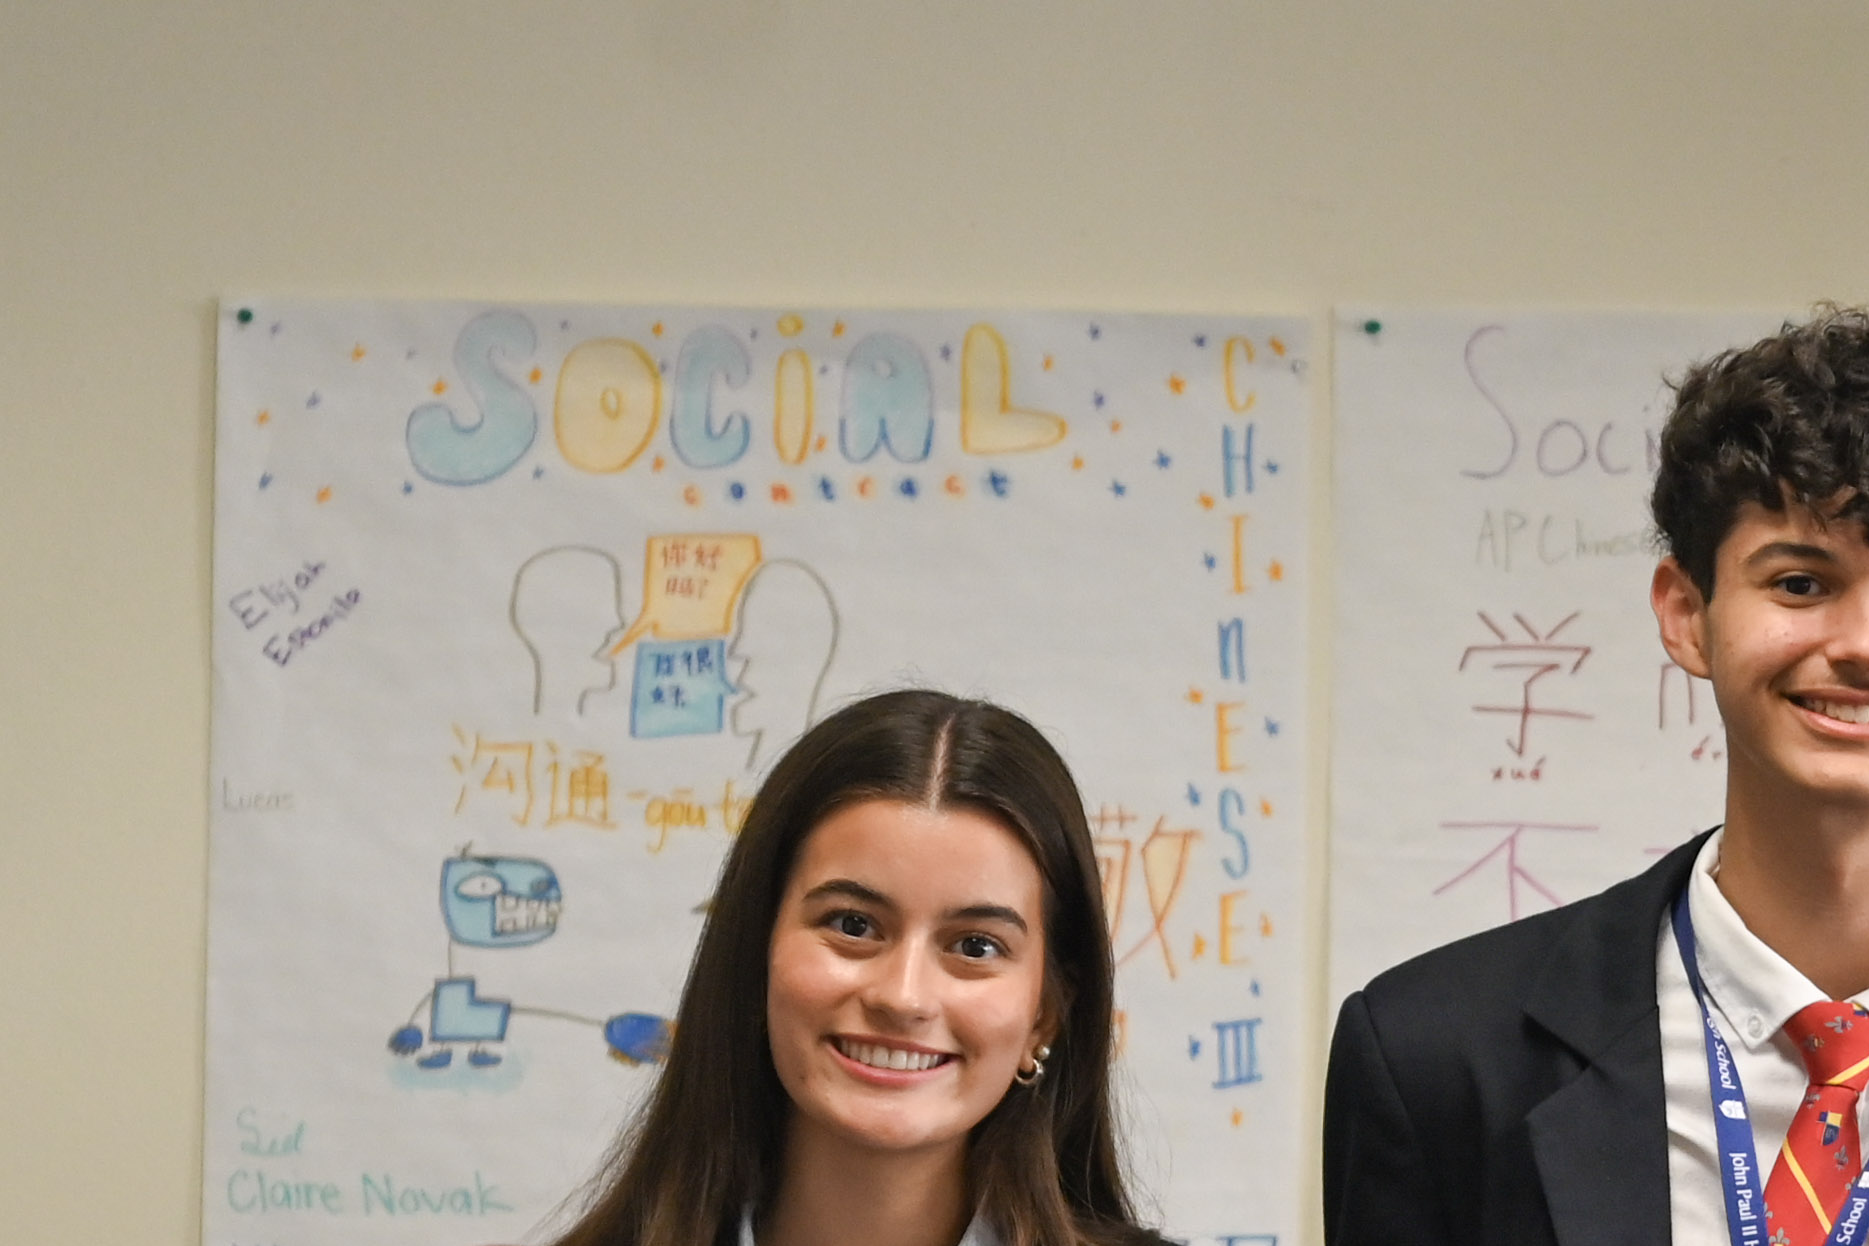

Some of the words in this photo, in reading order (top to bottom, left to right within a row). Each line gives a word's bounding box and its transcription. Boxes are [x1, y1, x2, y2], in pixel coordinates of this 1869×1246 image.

[1459, 610, 1596, 758] 学
[450, 722, 619, 831] 沟通
[1715, 1040, 1737, 1090] School
[227, 1168, 343, 1214] Claire
[361, 1170, 513, 1217] Novak
[1729, 1152, 1750, 1186] John
[1736, 1189, 1758, 1221] Paul
[1836, 1197, 1867, 1246] School
[1741, 1225, 1758, 1236] II
